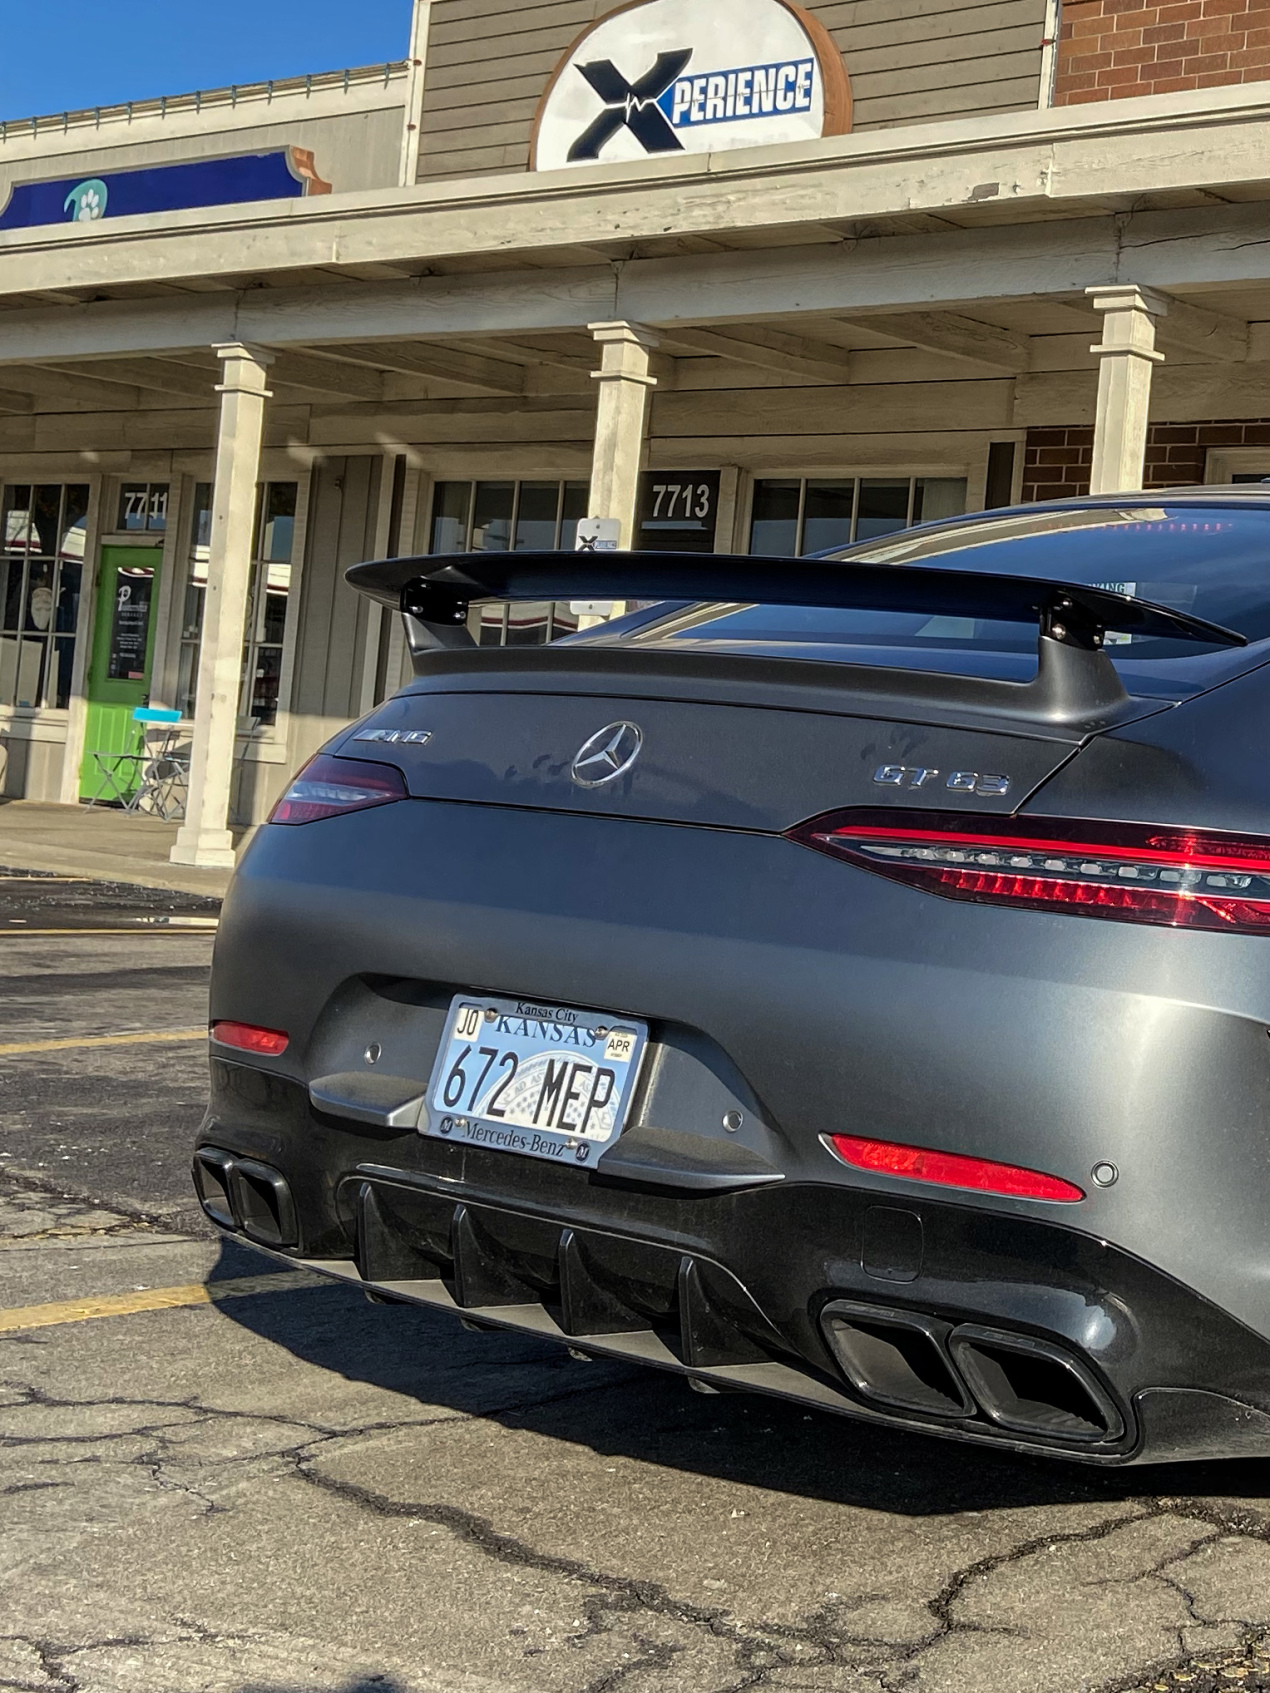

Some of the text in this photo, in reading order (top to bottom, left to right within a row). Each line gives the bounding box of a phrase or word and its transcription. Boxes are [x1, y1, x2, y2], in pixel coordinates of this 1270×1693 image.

[567, 48, 813, 162] XPERIENCE
[124, 492, 168, 520] 7711
[652, 484, 710, 518] 7713
[873, 764, 1010, 795] GT 63
[515, 1003, 580, 1024] Kansas City
[495, 1015, 597, 1048] KANSAS
[607, 1038, 631, 1054] APR
[443, 1044, 615, 1134] 672 MEP
[461, 1121, 566, 1157] Mercedes-Benz
